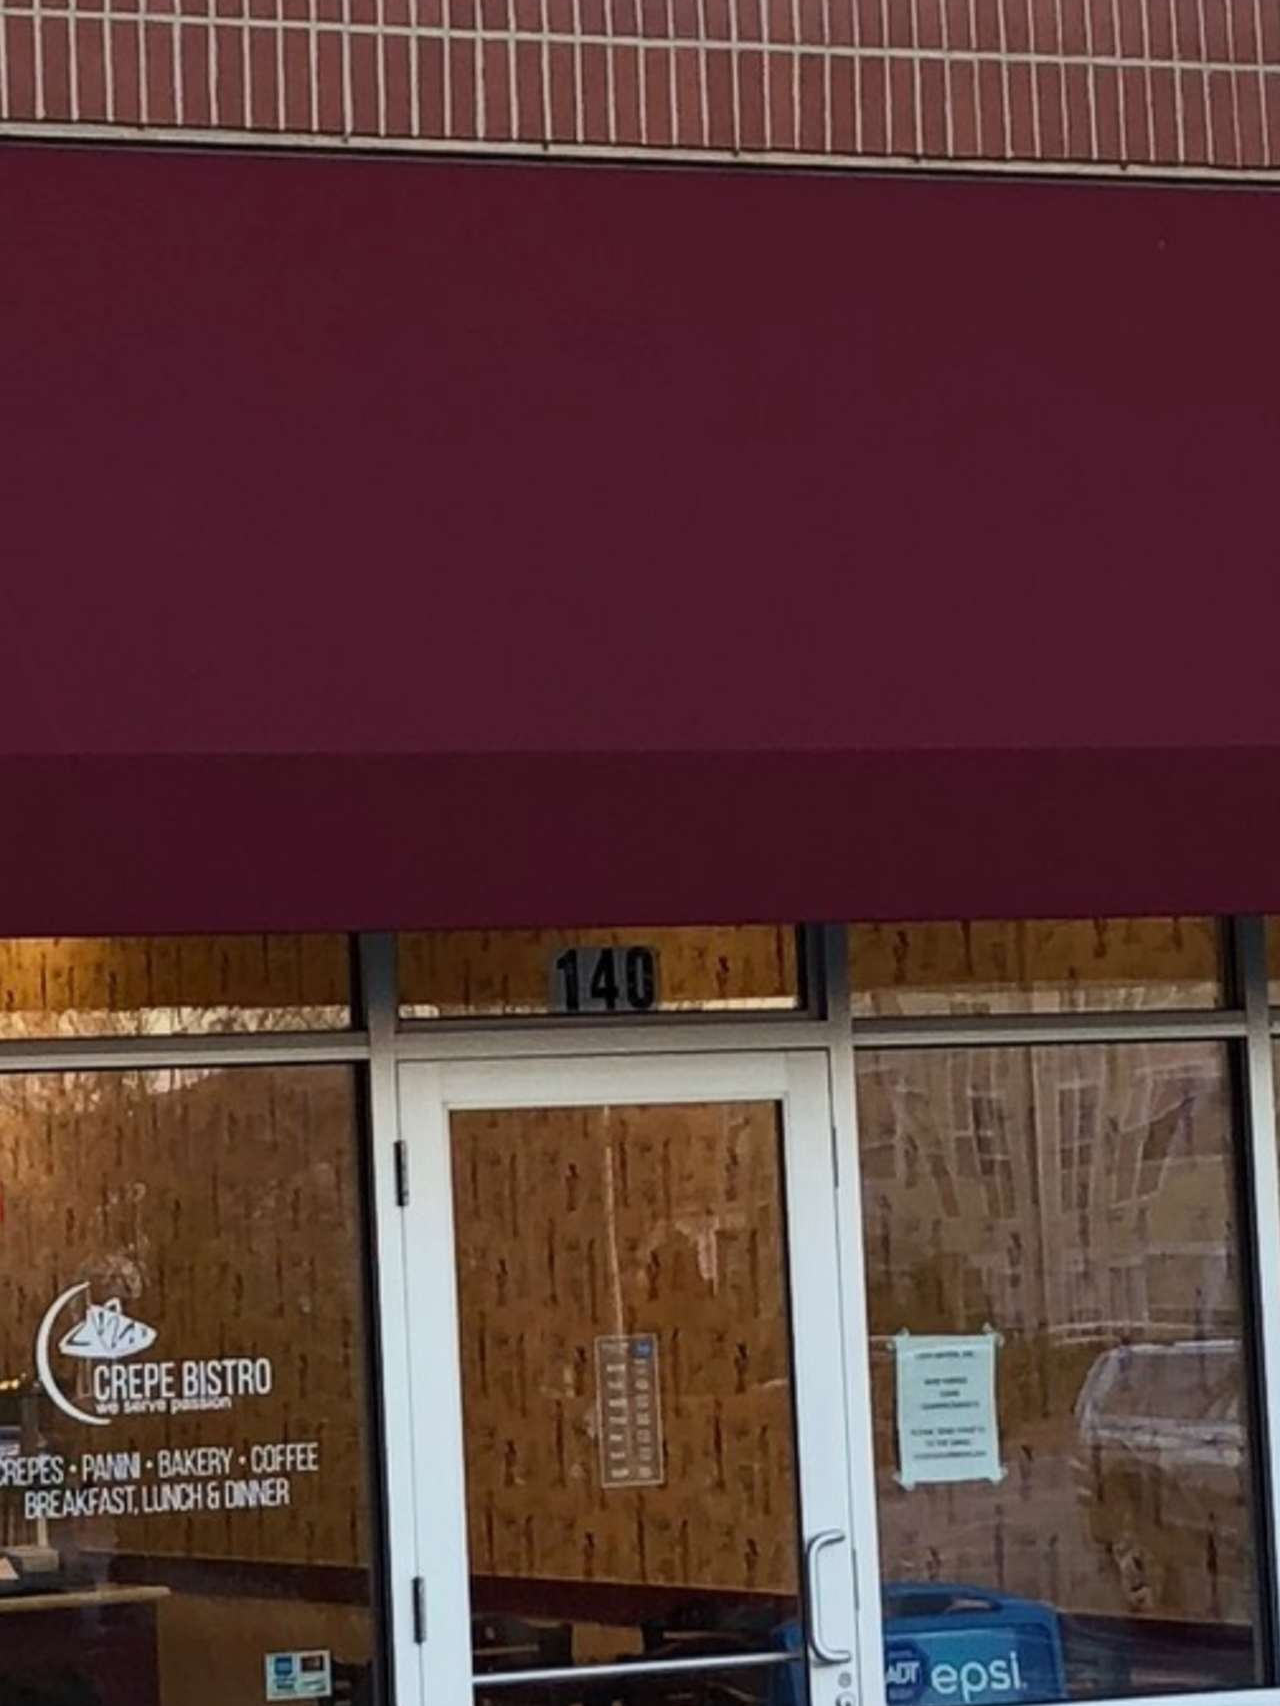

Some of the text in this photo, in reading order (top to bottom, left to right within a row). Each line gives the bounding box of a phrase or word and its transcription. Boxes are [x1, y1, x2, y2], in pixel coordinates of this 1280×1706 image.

[556, 945, 654, 1011] 140
[93, 1357, 272, 1401] CREPE BISTRO
[95, 1395, 233, 1415] we serve passion
[157, 1447, 234, 1480] BAKERY
[250, 1442, 319, 1473] COFFEE
[24, 1477, 291, 1520] BREAKFAST, LUNCH & DINNER
[885, 1659, 920, 1686] ADT
[930, 1650, 1021, 1704] epsi
